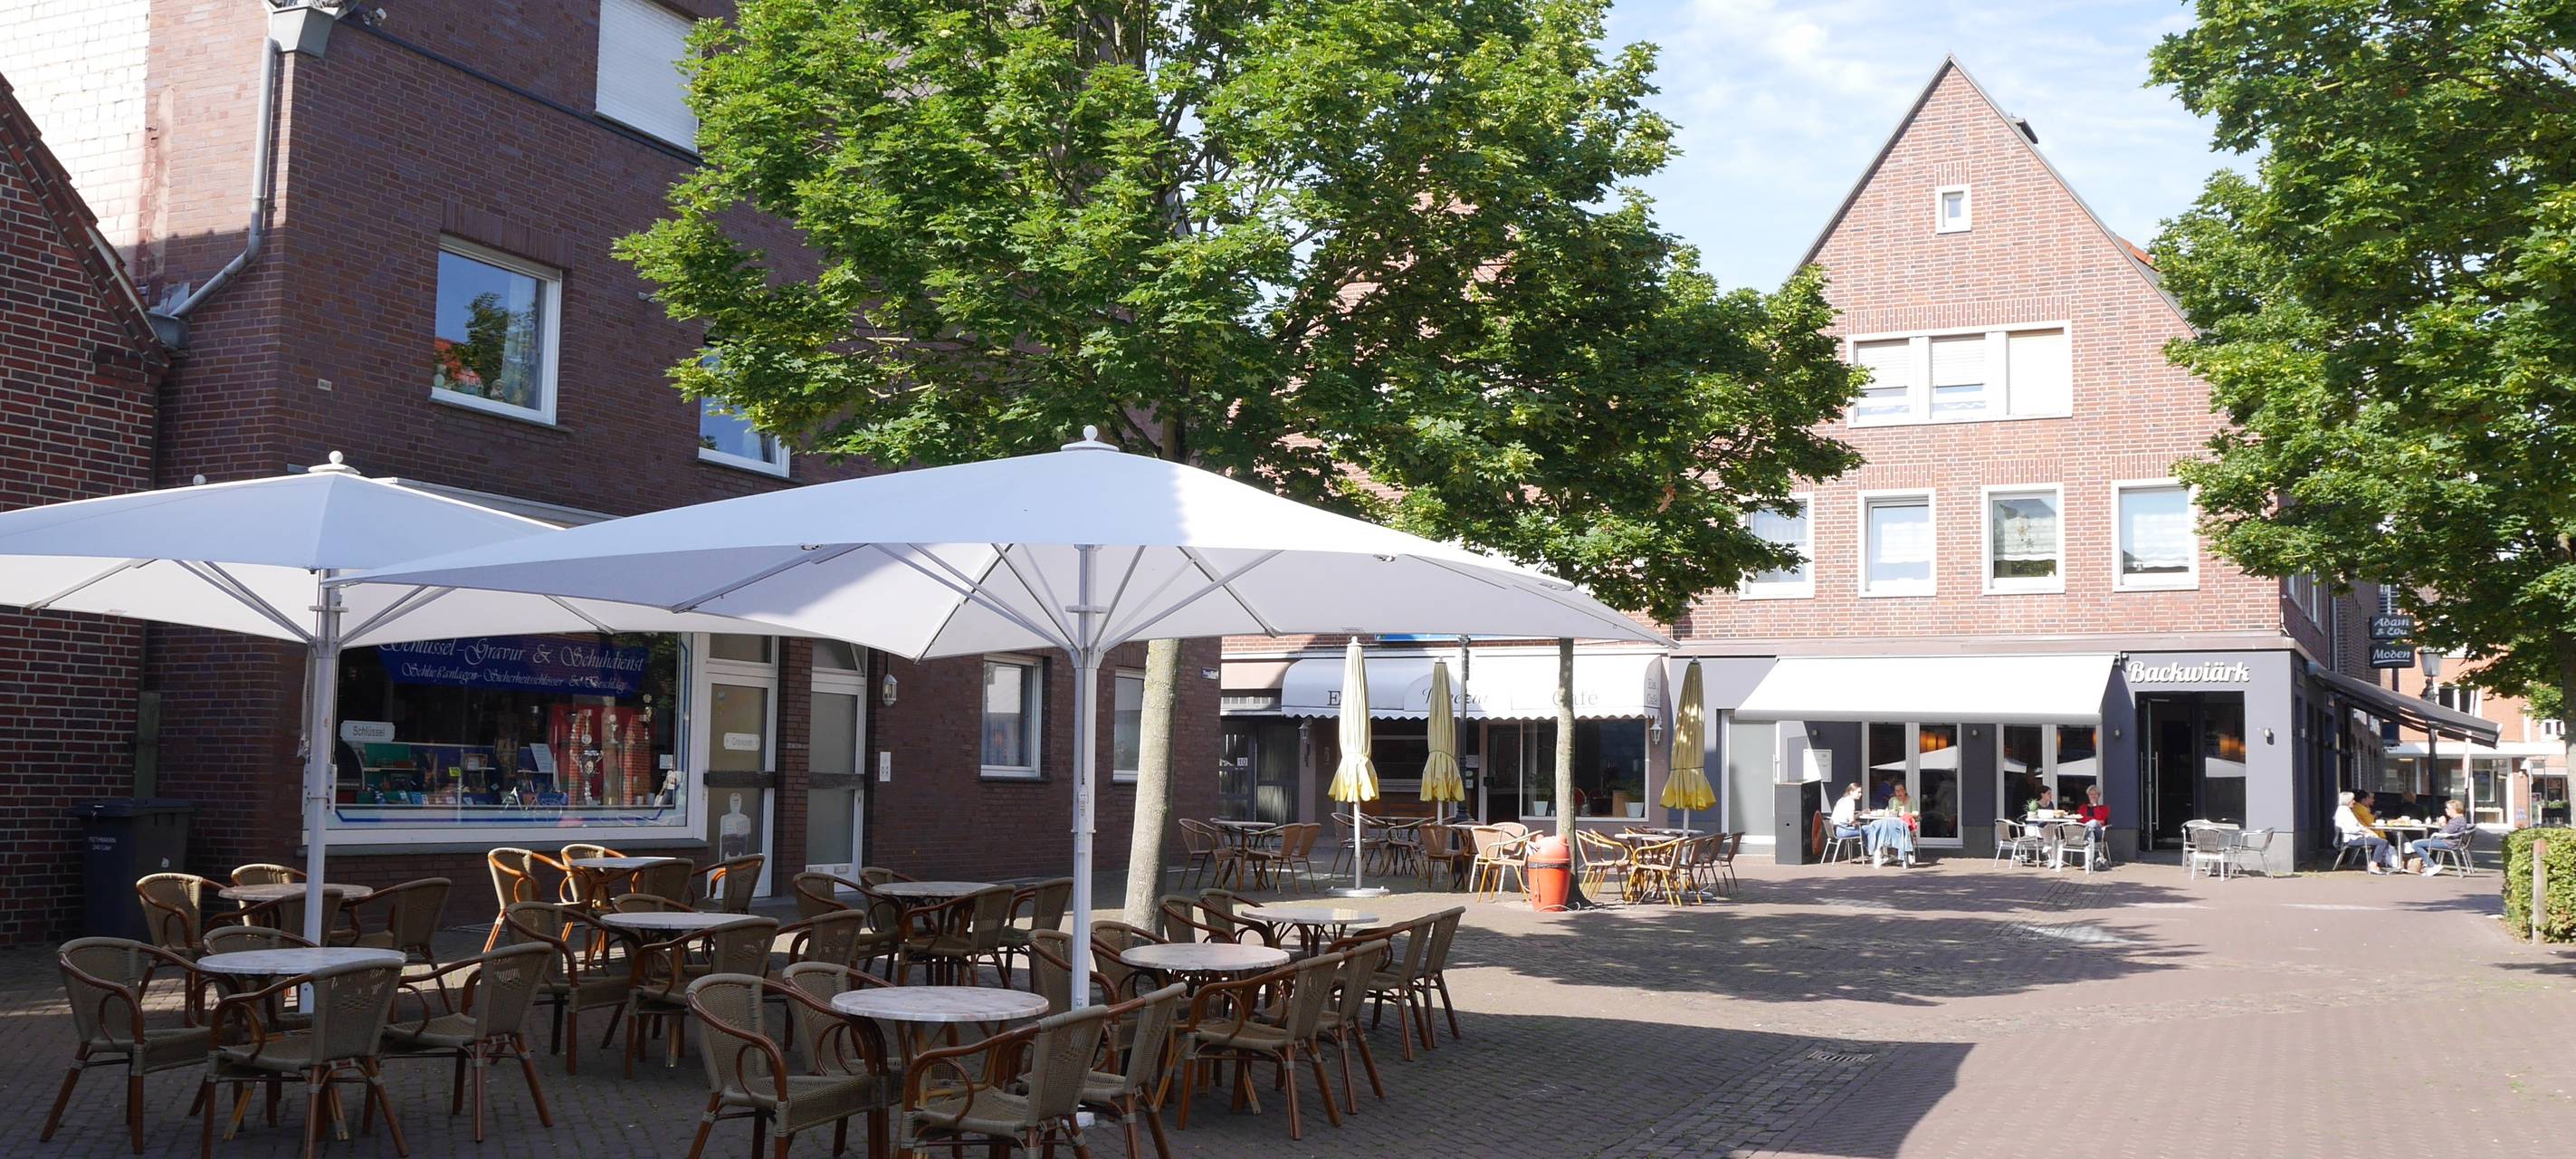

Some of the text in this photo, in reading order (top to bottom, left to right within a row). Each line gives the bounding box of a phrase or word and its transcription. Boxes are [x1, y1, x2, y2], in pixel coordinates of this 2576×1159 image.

[2374, 618, 2409, 627] Adam
[532, 644, 553, 664] &
[560, 646, 644, 671] Schuhdienst
[2372, 648, 2410, 660] Moden
[2127, 661, 2250, 684] Backwiärk
[353, 725, 385, 737] Schlüssel
